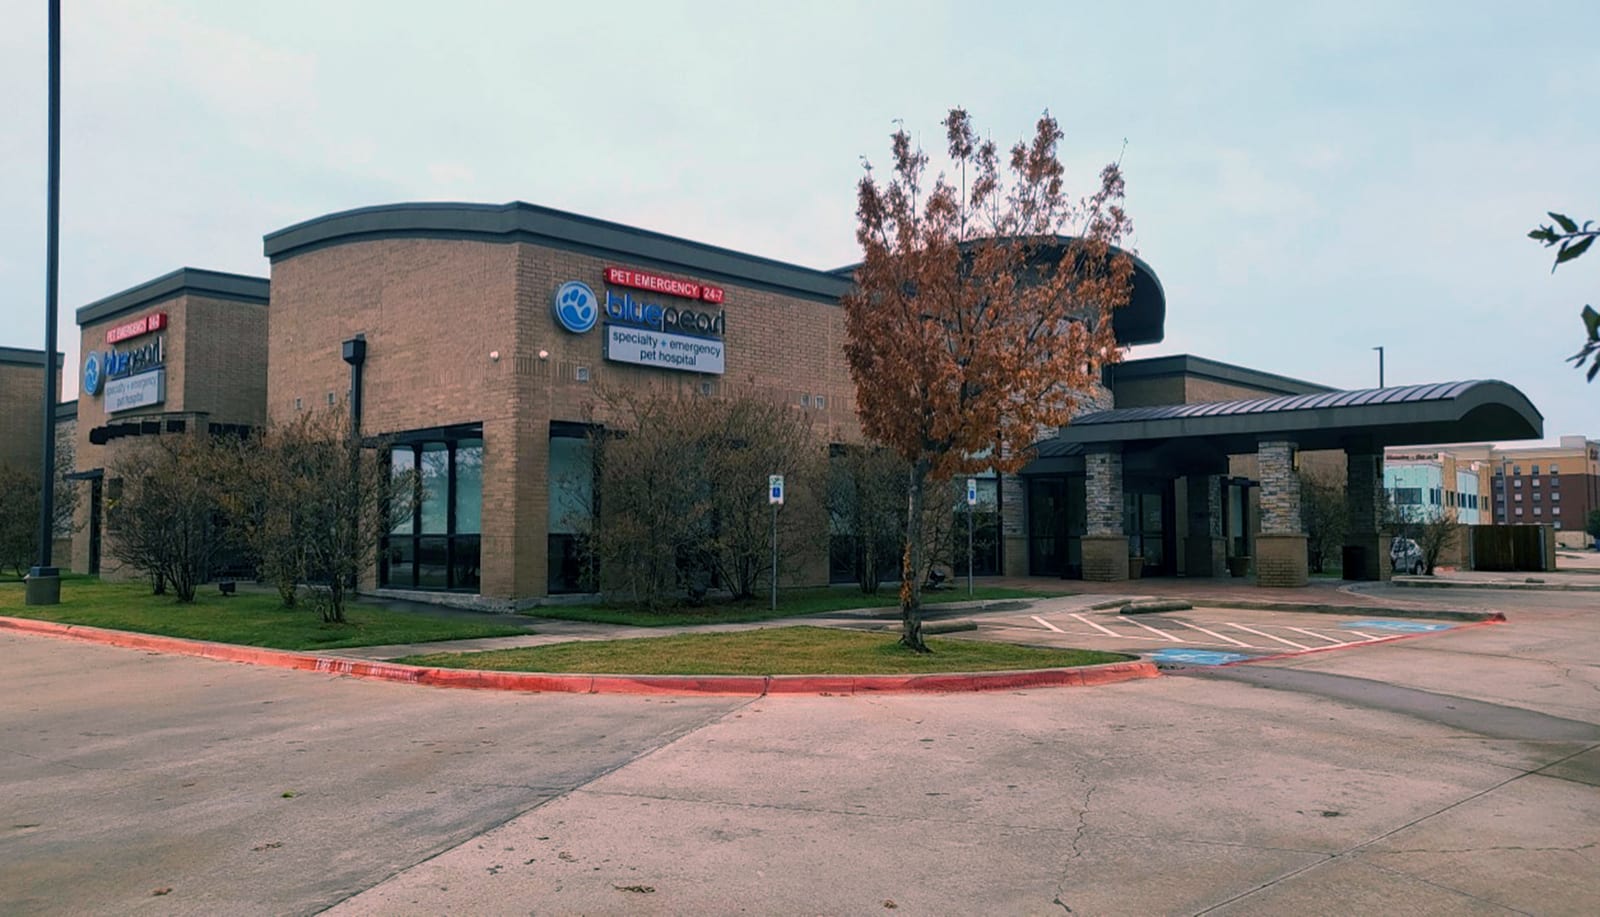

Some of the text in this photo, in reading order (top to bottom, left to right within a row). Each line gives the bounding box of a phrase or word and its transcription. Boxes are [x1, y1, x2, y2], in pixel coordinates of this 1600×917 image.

[610, 269, 723, 300] PET EMERGENCY 24-7
[605, 289, 725, 335] bluepearl
[613, 331, 658, 348] specialty
[669, 340, 721, 358] emergency
[640, 348, 697, 367] pet hospital
